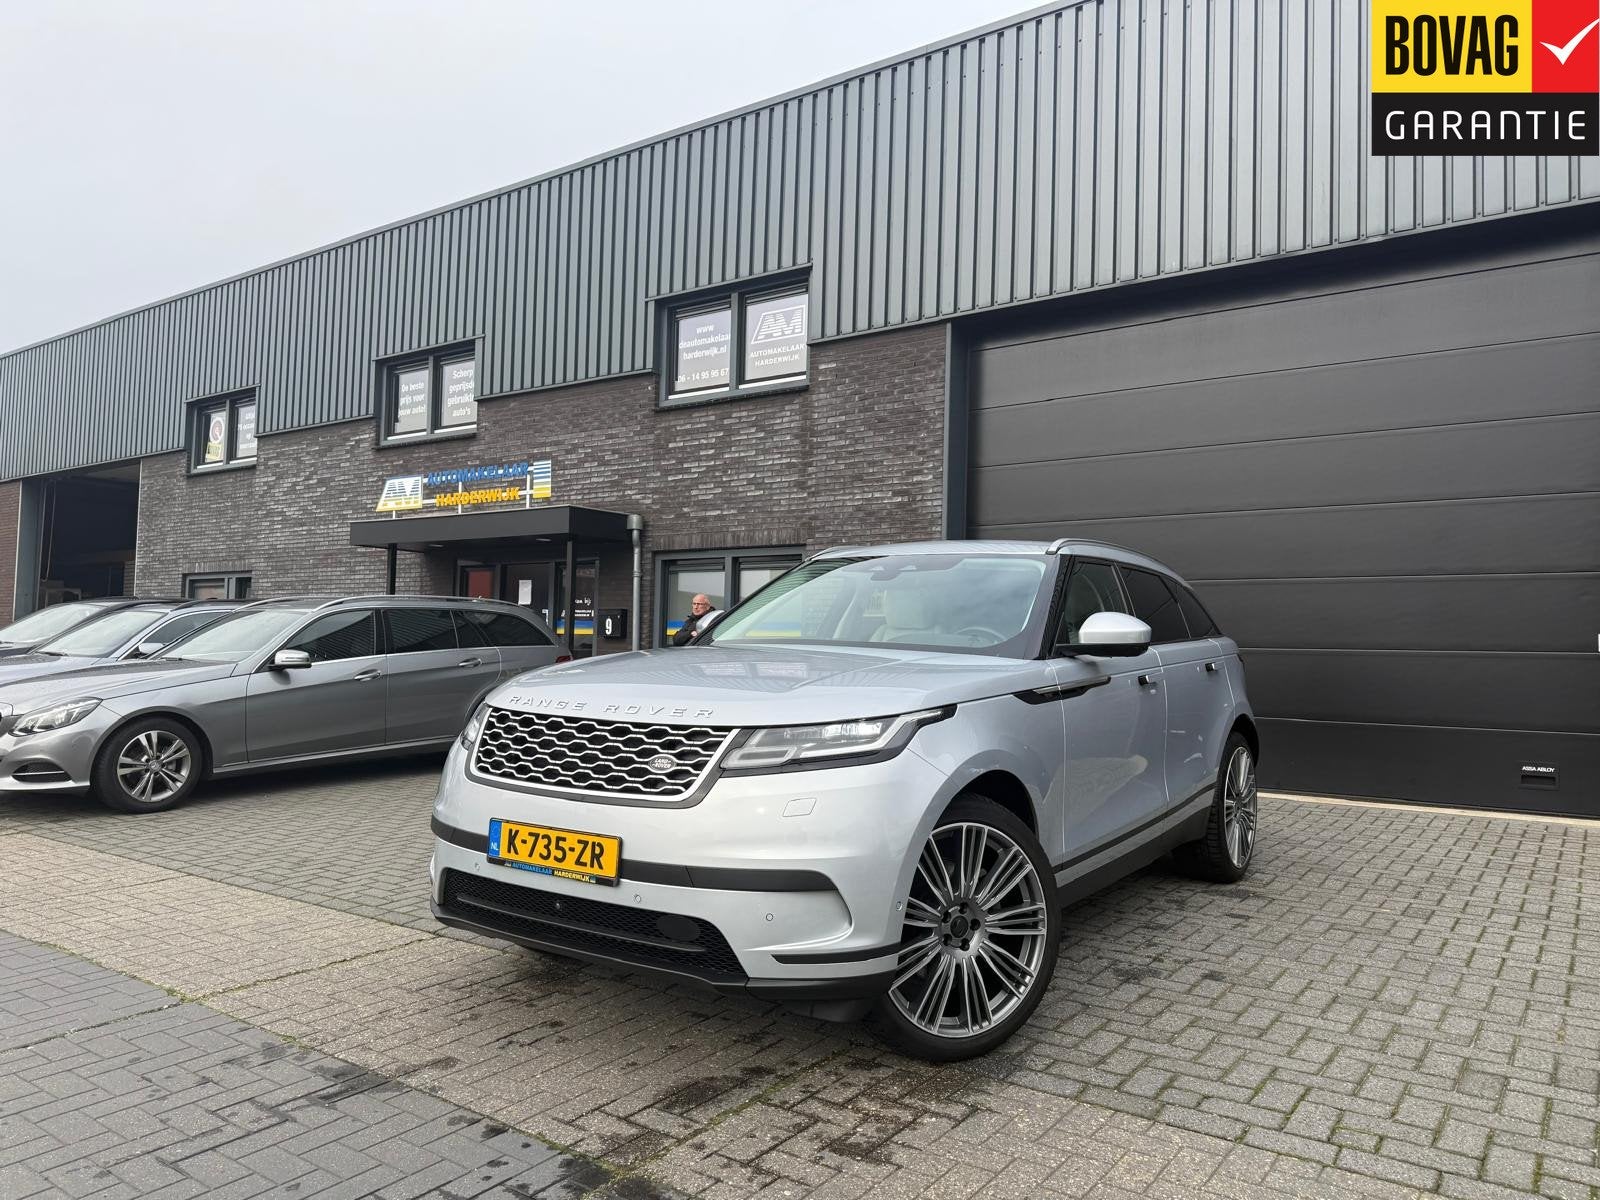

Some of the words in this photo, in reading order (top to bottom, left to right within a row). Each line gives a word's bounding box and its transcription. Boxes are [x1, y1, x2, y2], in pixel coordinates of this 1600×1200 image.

[696, 324, 714, 334] www
[683, 345, 727, 360] harderwijk.nl
[755, 354, 800, 367] HARDERWIJK
[453, 369, 474, 379] Scherp
[427, 463, 529, 486] AUTOMAKELAAR
[434, 486, 521, 507] HARDERWIJK
[605, 618, 613, 635] 9
[509, 696, 588, 711] RANGE
[603, 703, 714, 719] ROVER
[490, 841, 499, 851] NL
[506, 828, 605, 871] K-735-ZR
[512, 862, 553, 876] AUTOMAKELAAR
[553, 869, 590, 882] HARDERWIJK
